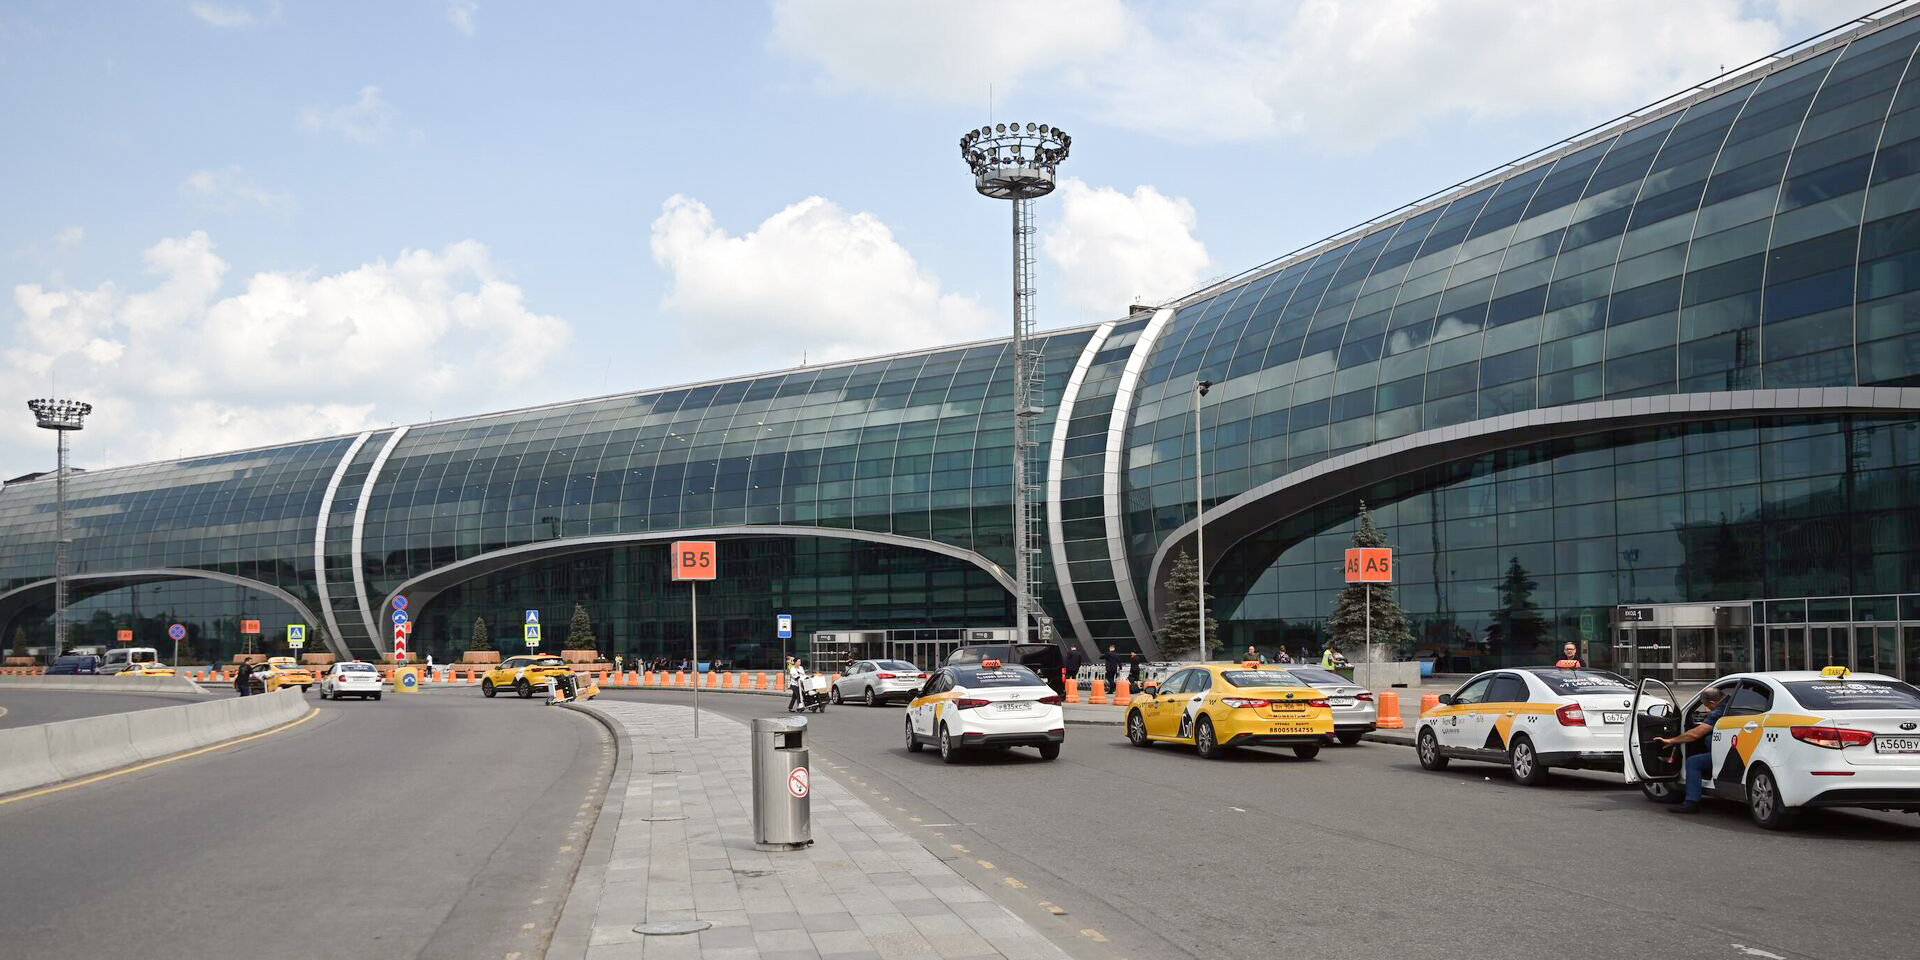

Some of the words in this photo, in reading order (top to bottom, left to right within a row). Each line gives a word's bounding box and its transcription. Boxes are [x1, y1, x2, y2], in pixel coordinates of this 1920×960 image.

[683, 552, 710, 568] B5
[1347, 558, 1359, 573] A5
[1366, 558, 1389, 572] A5
[1637, 610, 1643, 620] 1
[1606, 713, 1627, 722] О676
[1880, 739, 1919, 749] А560ВУ
